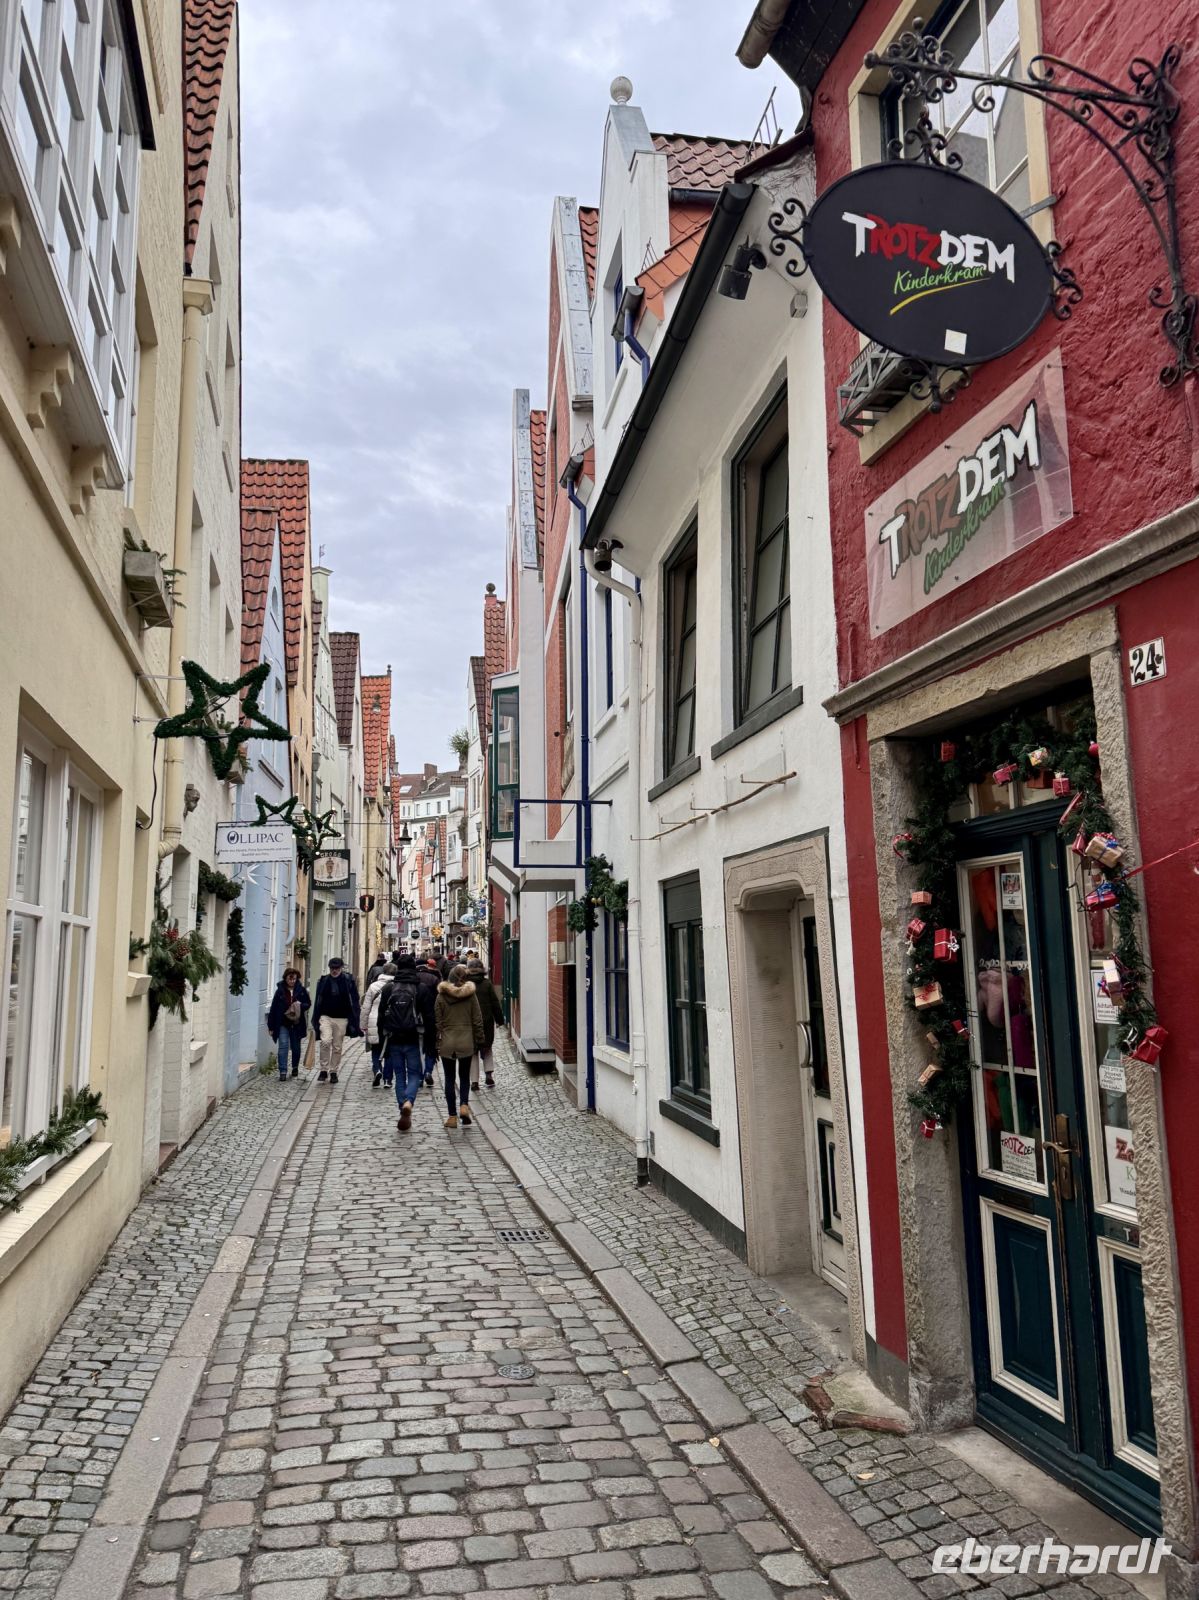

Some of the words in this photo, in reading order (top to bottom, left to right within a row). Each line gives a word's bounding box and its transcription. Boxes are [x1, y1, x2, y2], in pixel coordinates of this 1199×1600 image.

[842, 212, 1015, 283] TROTZDEM
[894, 262, 985, 295] Kinderkram
[879, 399, 1042, 579] TROTZDEM
[1132, 643, 1160, 682] 24
[227, 830, 284, 844] OLLIPAC
[1126, 1166, 1135, 1181] K
